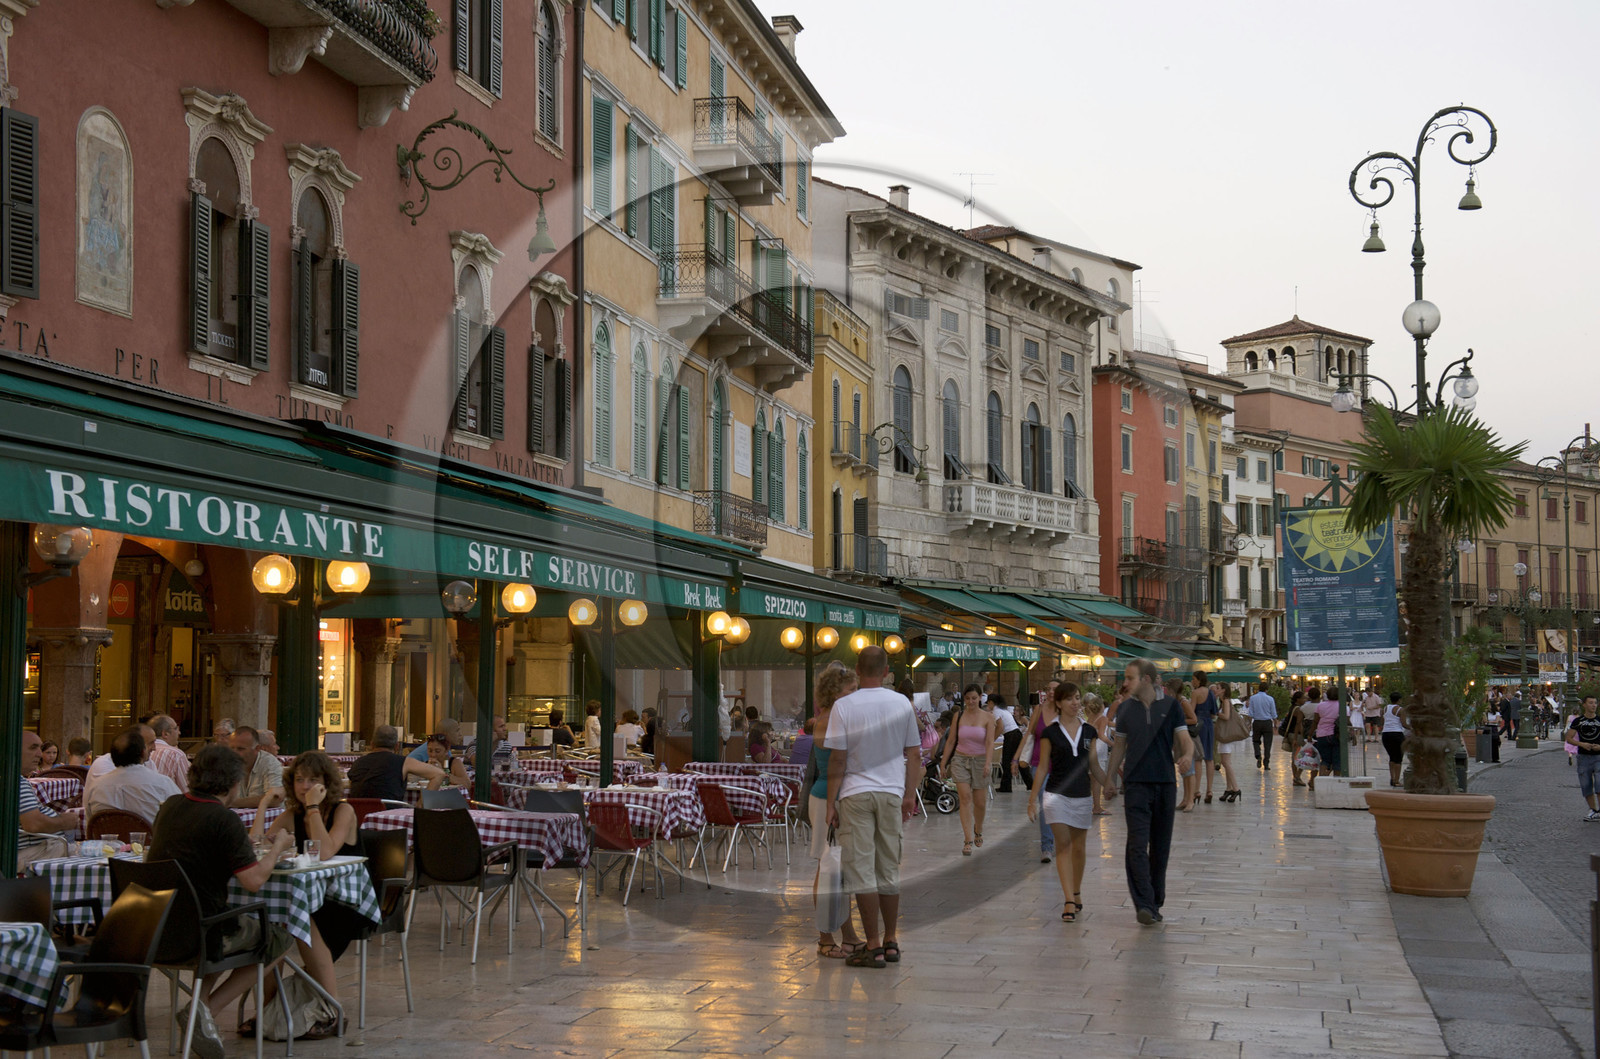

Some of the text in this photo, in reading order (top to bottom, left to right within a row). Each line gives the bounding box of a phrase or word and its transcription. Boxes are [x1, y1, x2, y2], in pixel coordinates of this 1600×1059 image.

[115, 348, 160, 385] PER
[207, 375, 228, 404] IL
[276, 394, 354, 429] TURISMO
[423, 433, 471, 462] VIAGGI
[495, 451, 565, 486] VALPANTENA
[45, 468, 384, 558] RISTORANTE
[467, 541, 636, 596] SELF SERVICE
[764, 594, 807, 619] SPIZZICO
